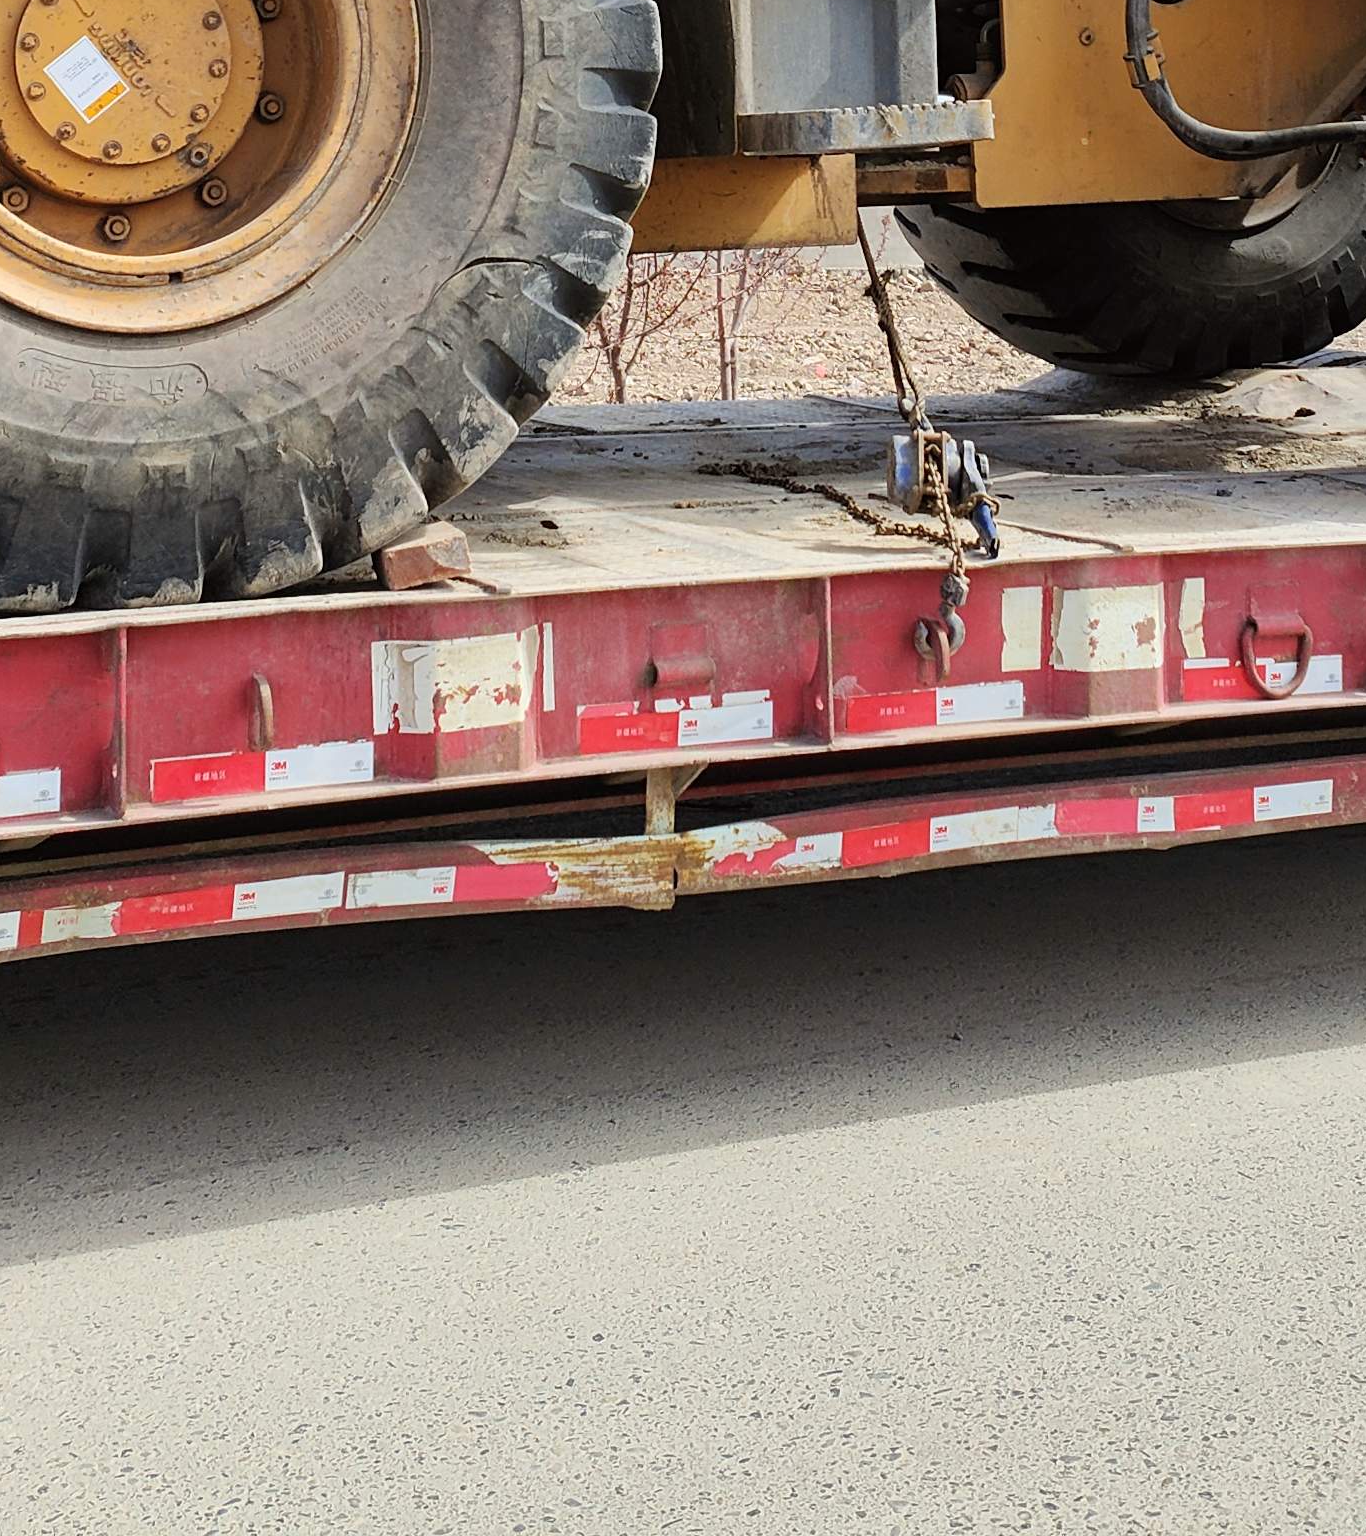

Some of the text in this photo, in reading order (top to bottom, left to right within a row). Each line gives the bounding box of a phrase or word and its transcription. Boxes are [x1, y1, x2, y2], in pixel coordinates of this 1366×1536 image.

[941, 698, 953, 707] 3M
[684, 719, 698, 729] 3M
[271, 761, 287, 771] 3M
[935, 826, 947, 834] 3M
[240, 892, 256, 902] 3M
